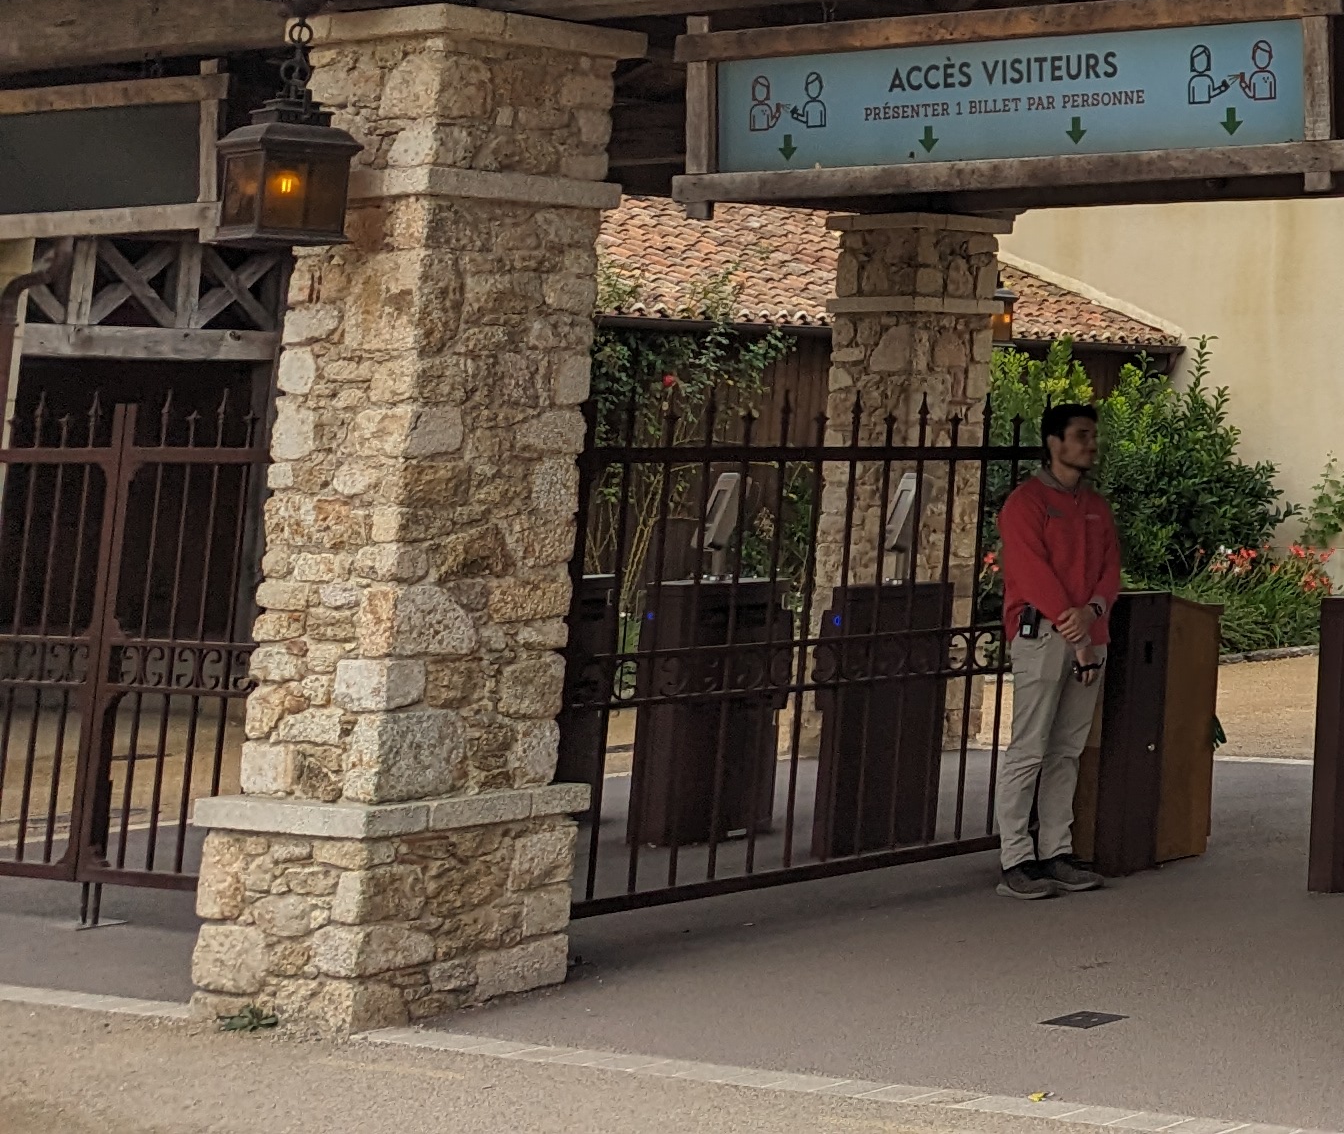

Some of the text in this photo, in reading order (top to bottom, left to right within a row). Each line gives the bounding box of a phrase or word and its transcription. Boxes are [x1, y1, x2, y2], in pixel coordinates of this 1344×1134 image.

[888, 52, 1118, 93] ACCÈS VISITEURS
[864, 89, 1145, 121] PRÉSENTER 1 BILLET PAR PERSONNE
